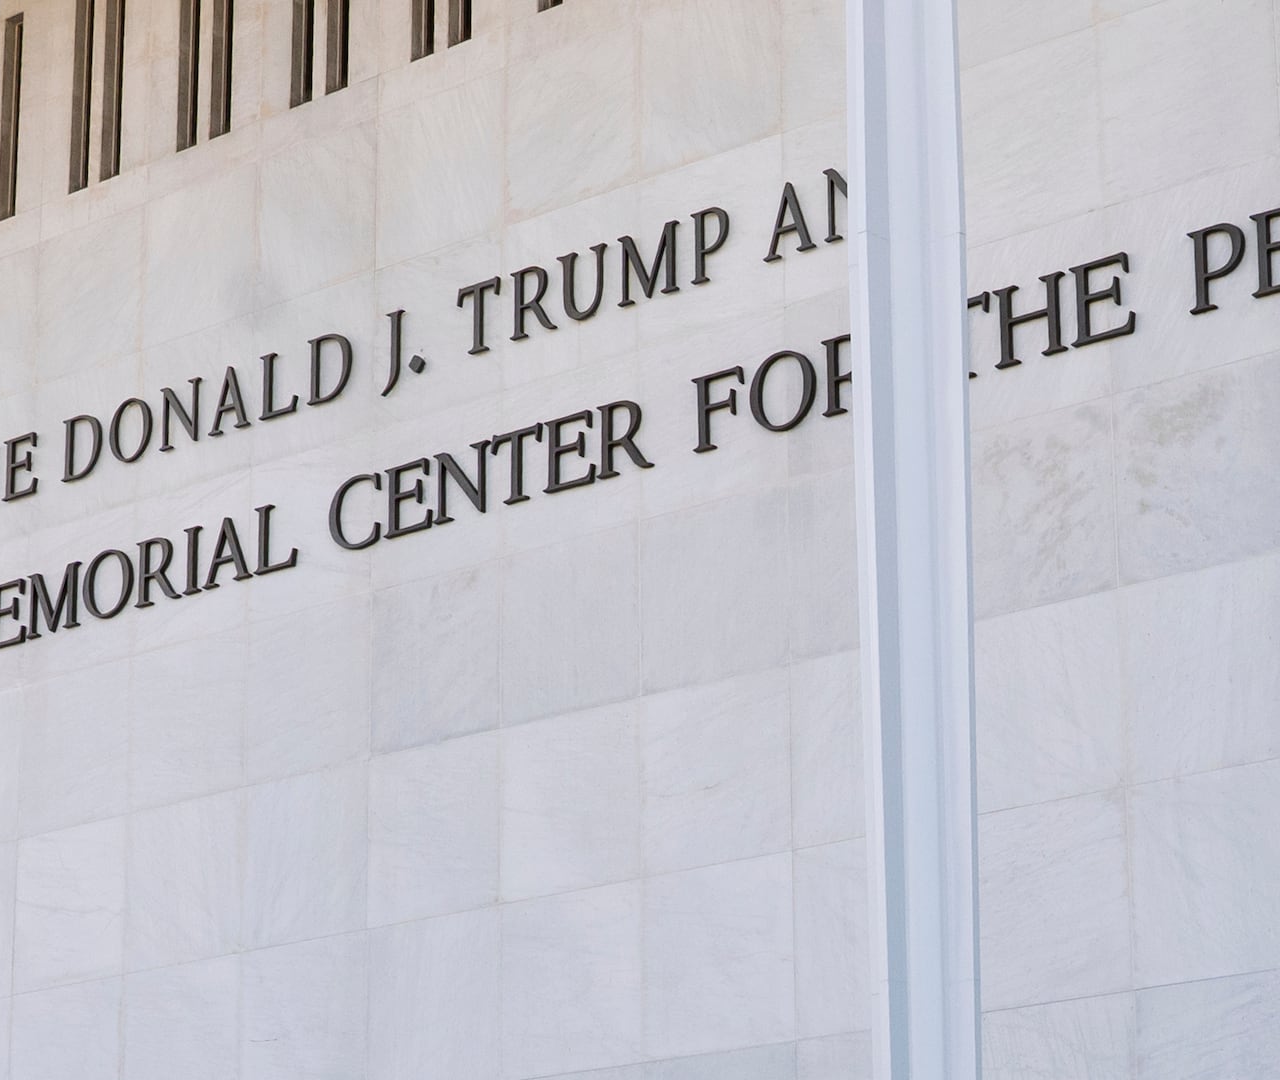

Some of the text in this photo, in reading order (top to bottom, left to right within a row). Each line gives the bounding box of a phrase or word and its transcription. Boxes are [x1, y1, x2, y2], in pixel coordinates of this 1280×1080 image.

[60, 333, 353, 483] DONALD
[380, 309, 427, 398] J.
[456, 206, 730, 356] TRUMP
[328, 400, 655, 551] CENTER
